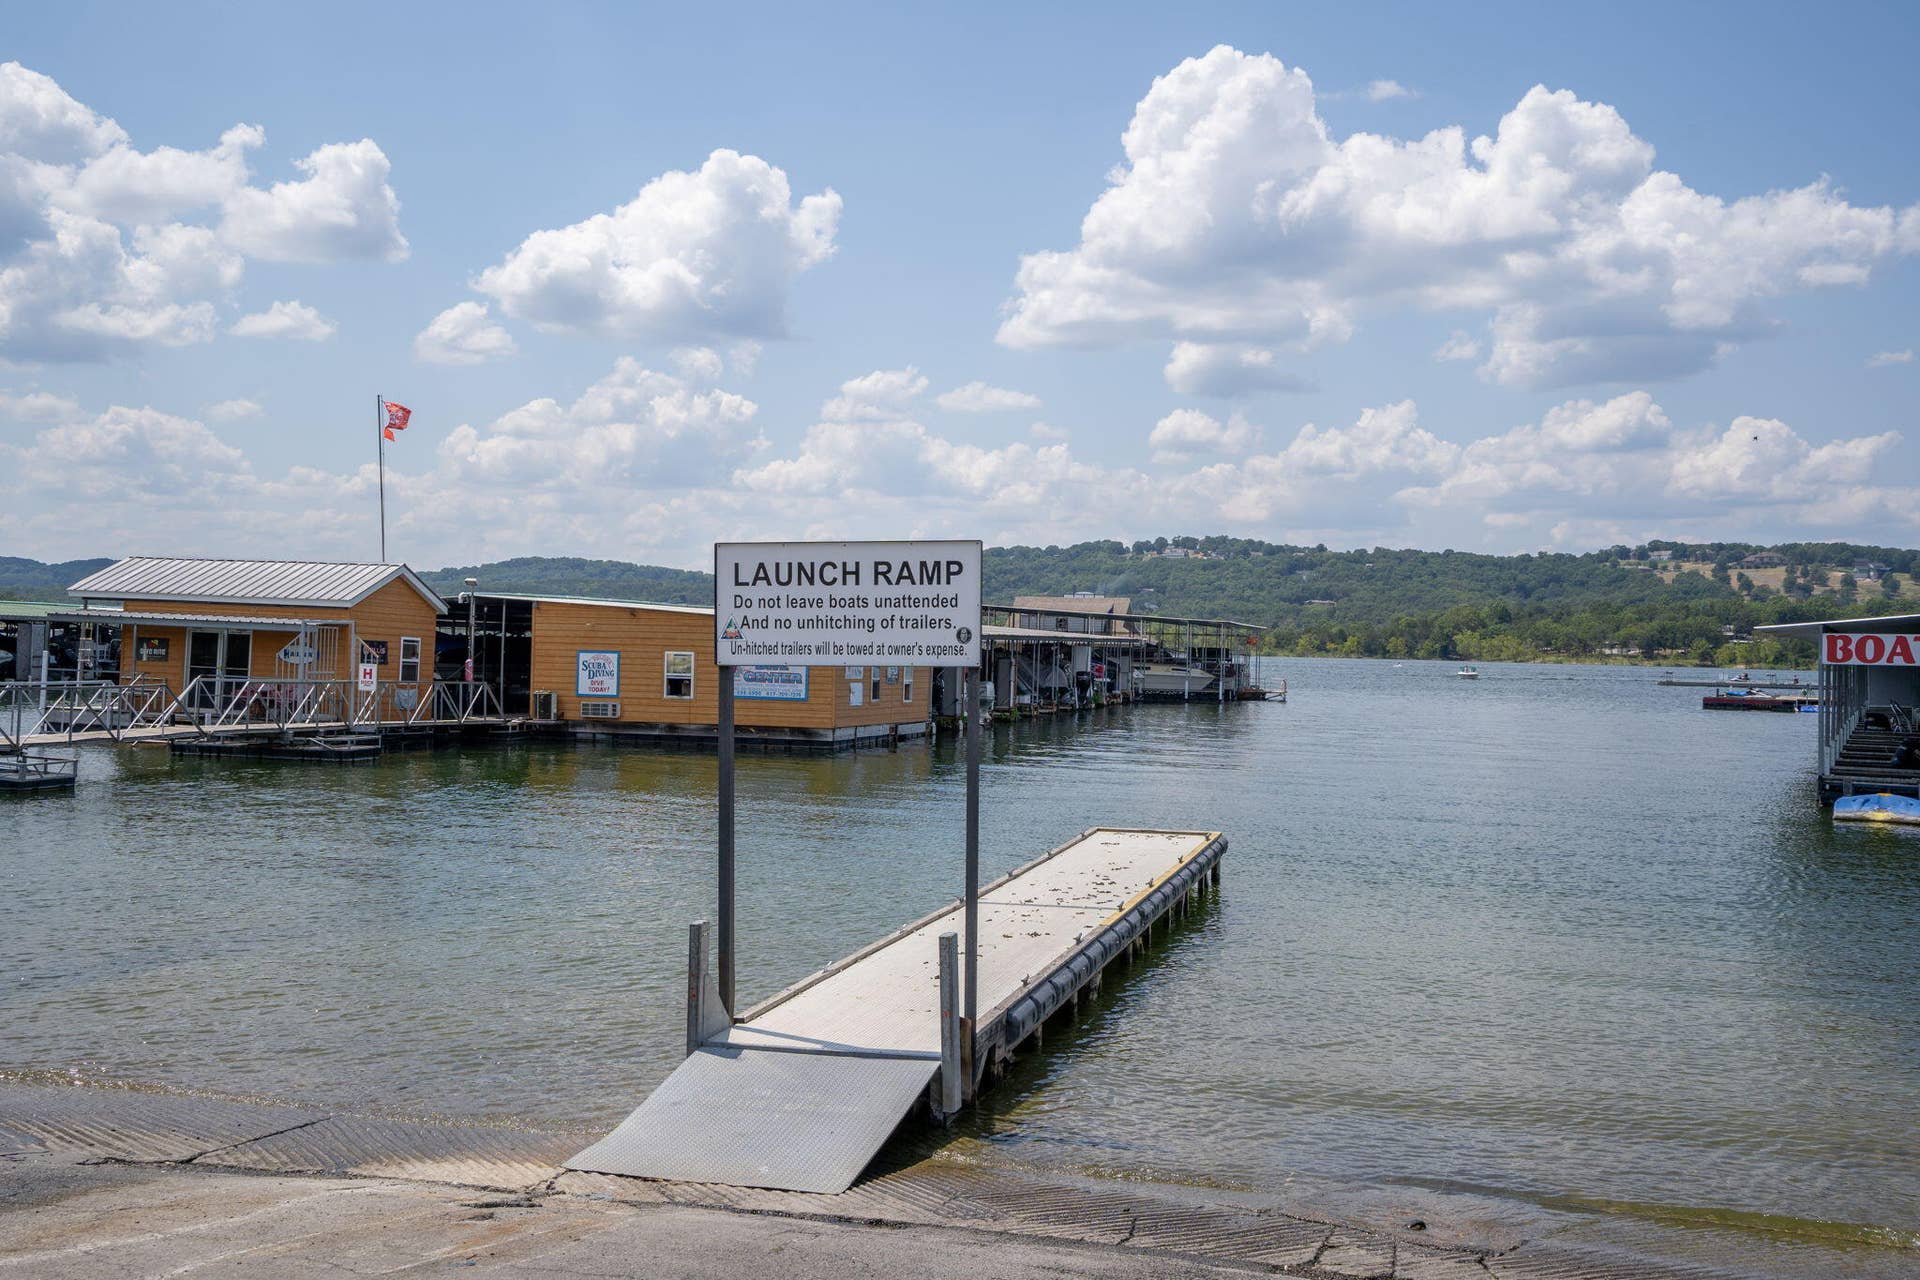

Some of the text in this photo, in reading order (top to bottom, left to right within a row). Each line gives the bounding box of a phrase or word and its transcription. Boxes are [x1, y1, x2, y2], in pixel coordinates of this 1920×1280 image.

[734, 560, 964, 586] LAUNCH RAMP
[734, 593, 958, 609] Do not leave boats unattended
[741, 614, 957, 633] And no unhitching of trailers.
[730, 641, 968, 660] Un-hitched trailers will be towed at owner's expense.
[582, 660, 607, 670] SCUBA
[363, 668, 373, 679] H
[588, 670, 614, 679] DIVING
[743, 671, 803, 684] CENTER
